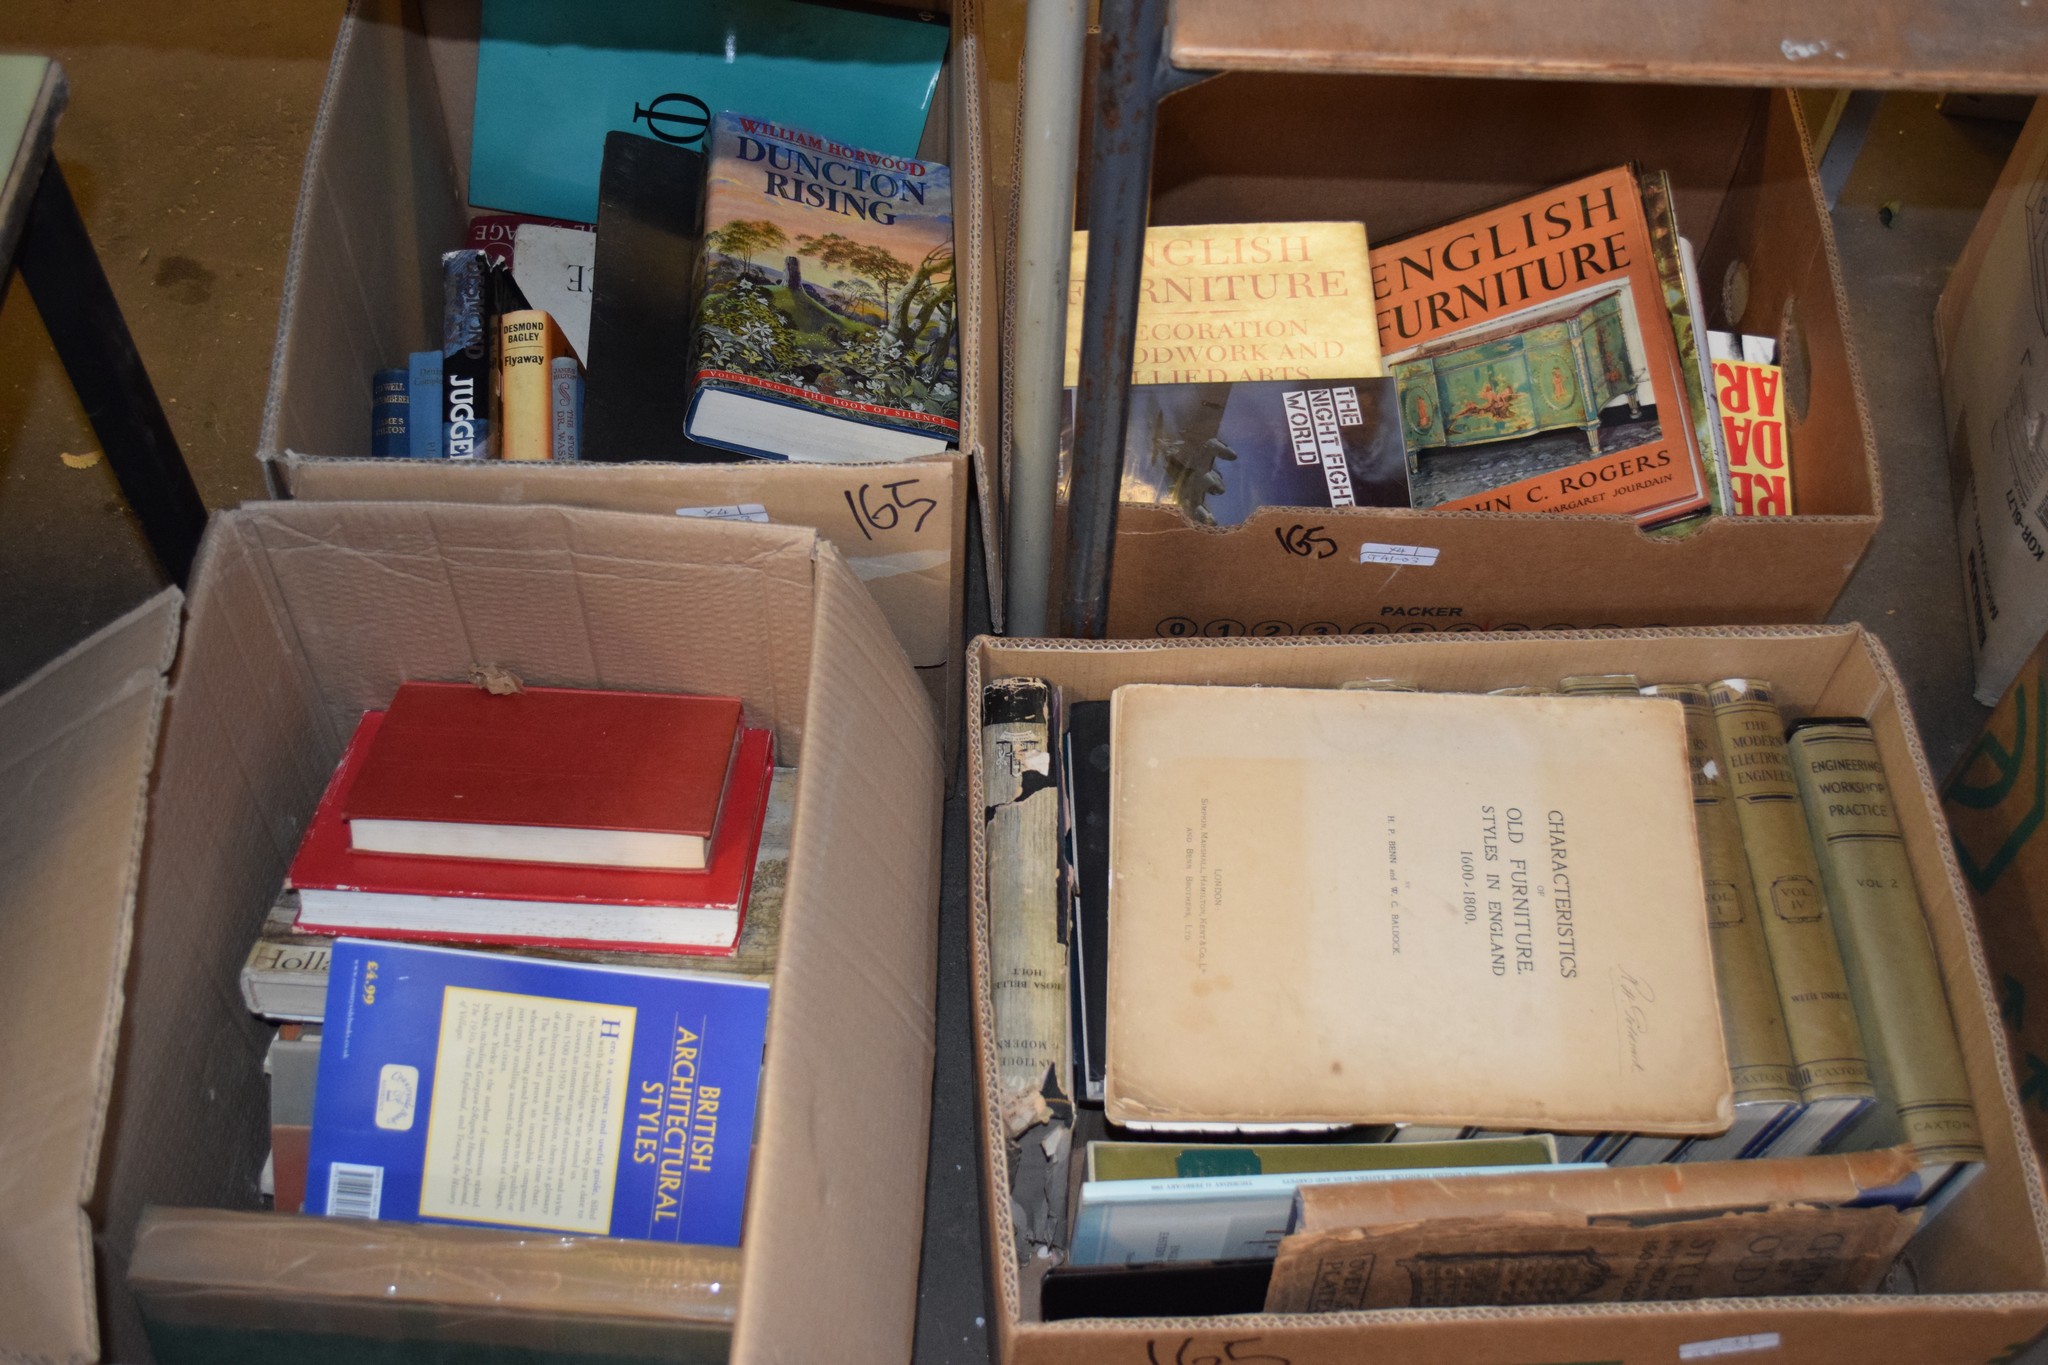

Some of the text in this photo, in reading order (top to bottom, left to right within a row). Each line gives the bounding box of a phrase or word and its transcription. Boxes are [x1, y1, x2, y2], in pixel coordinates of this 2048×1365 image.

[738, 118, 927, 177] WILLIAM HORWOOD
[736, 136, 927, 206] DUNCTON
[764, 170, 898, 225] RISING
[1372, 186, 1619, 300] ENGLISH
[1376, 232, 1631, 349] FURNITURE
[504, 321, 544, 334] DESMOND
[508, 332, 540, 344] BAGLEY
[1135, 319, 1308, 341] ECORATION
[503, 354, 545, 367] Flyaway
[1280, 341, 1345, 361] AND
[801, 390, 826, 401] THE
[832, 397, 867, 410] BOOK
[894, 408, 946, 425] SILENCE
[1336, 387, 1360, 425] THE
[1711, 363, 1780, 417] AR
[449, 374, 475, 460] JUGGE
[1286, 392, 1317, 464] WORLD
[1310, 389, 1340, 447] NIGHT
[557, 411, 566, 461] DR. WASS
[567, 410, 575, 460] THE STOR
[1526, 485, 1549, 504] C.
[1560, 450, 1672, 494] ROGERS
[1541, 473, 1673, 513] MARGARET JOURDAIN
[844, 480, 937, 541] 165
[1275, 524, 1338, 559] 165
[1380, 605, 1463, 618] PACKER
[1732, 736, 1783, 749] MODERN
[1743, 720, 1766, 731] THE
[1811, 758, 1882, 774] ENGINEERING
[1819, 781, 1885, 795] WORKSHOP
[1829, 803, 1888, 817] PRACTICE
[1185, 827, 1193, 842] AND
[1388, 840, 1398, 864] BENN
[1185, 848, 1194, 870] BENN
[1389, 868, 1398, 881] and
[1481, 804, 1506, 977] STYLES IN ENGLAND
[1504, 807, 1535, 974] OLD FURNITURE.
[1546, 809, 1578, 979] CHARACTERISTICS
[1856, 878, 1899, 888] VOL 2
[1010, 968, 1043, 977] HOLT
[1033, 981, 1061, 990] ROSA
[598, 1018, 620, 1054] Here
[996, 1039, 1047, 1050] MODERN
[600, 1077, 613, 1114] compact
[598, 1118, 608, 1134] and
[633, 1080, 665, 1164] STYLES
[653, 1026, 699, 1223] ARCHITECTURAL
[688, 1085, 722, 1173] BRITISH
[1913, 1119, 1971, 1132] CAXTON
[594, 1138, 606, 1164] useful
[591, 1168, 603, 1195] guide,
[588, 1199, 599, 1220] filled
